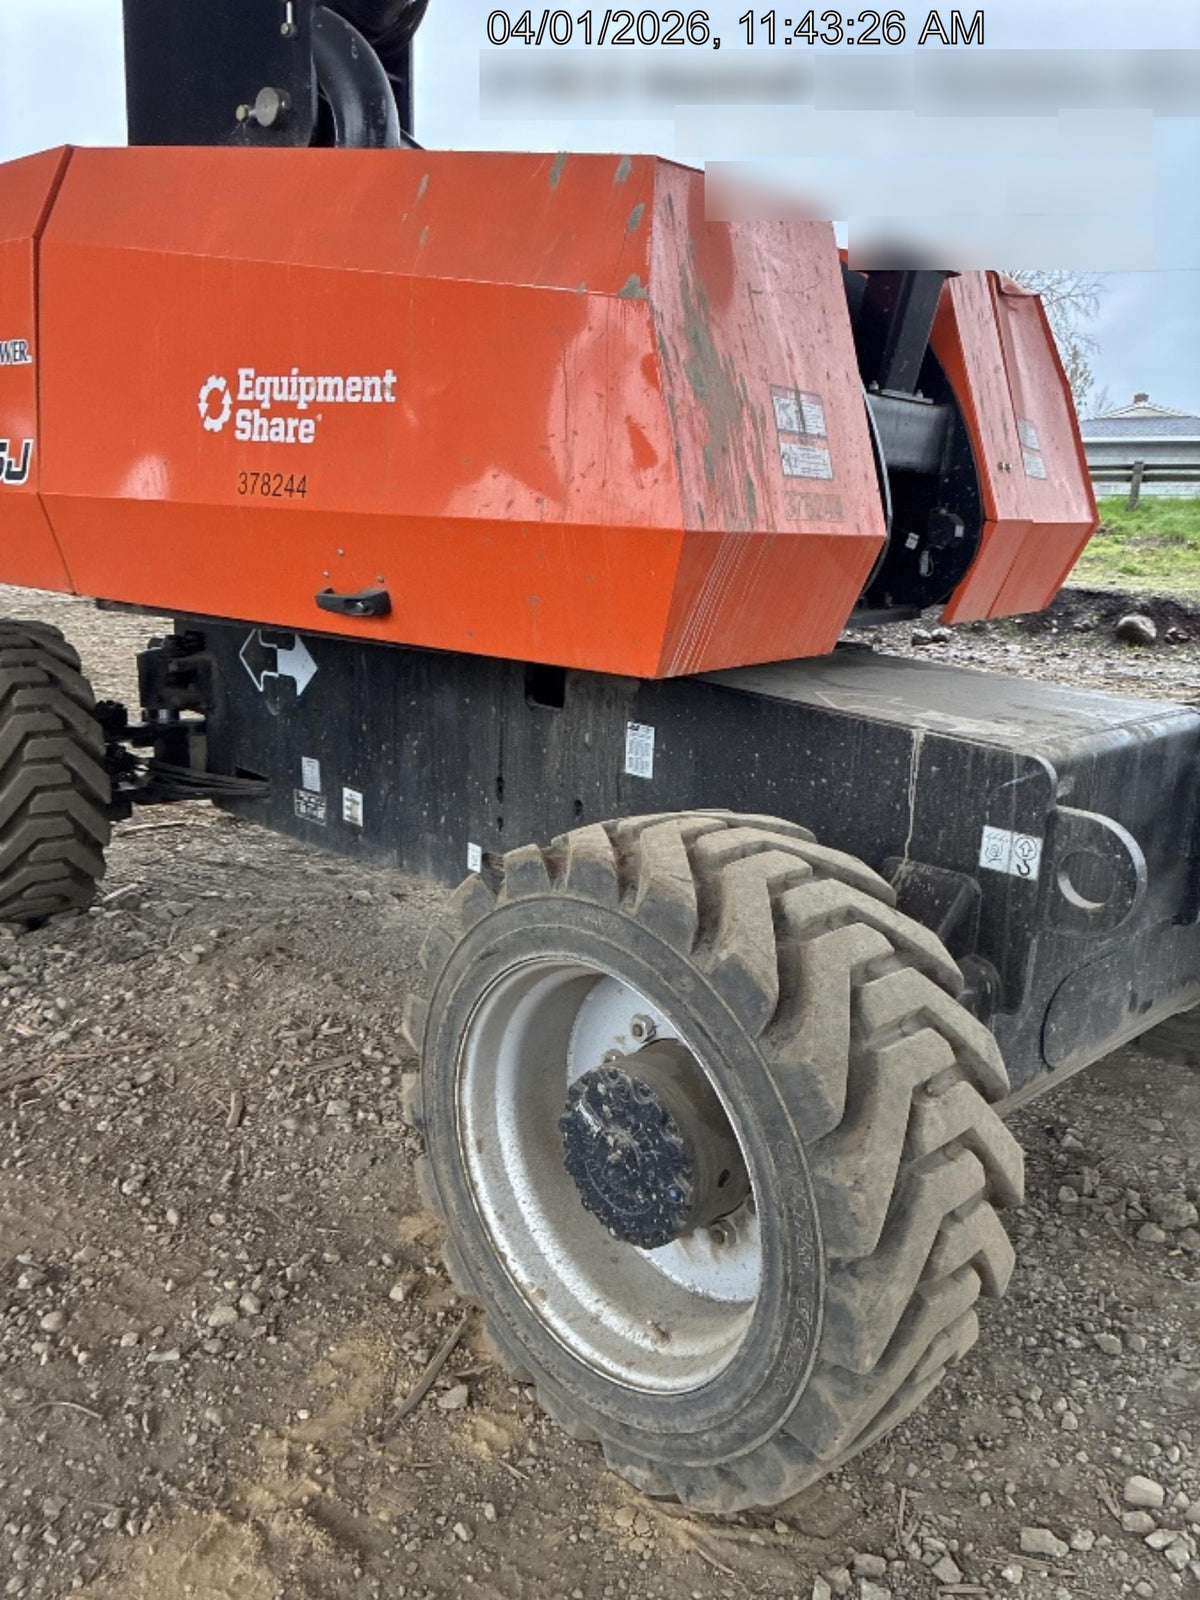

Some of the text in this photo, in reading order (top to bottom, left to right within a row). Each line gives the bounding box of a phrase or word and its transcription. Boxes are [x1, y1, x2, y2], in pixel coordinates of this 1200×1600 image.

[236, 367, 397, 410] Equipment
[234, 408, 316, 444] Share
[237, 471, 308, 499] 378244
